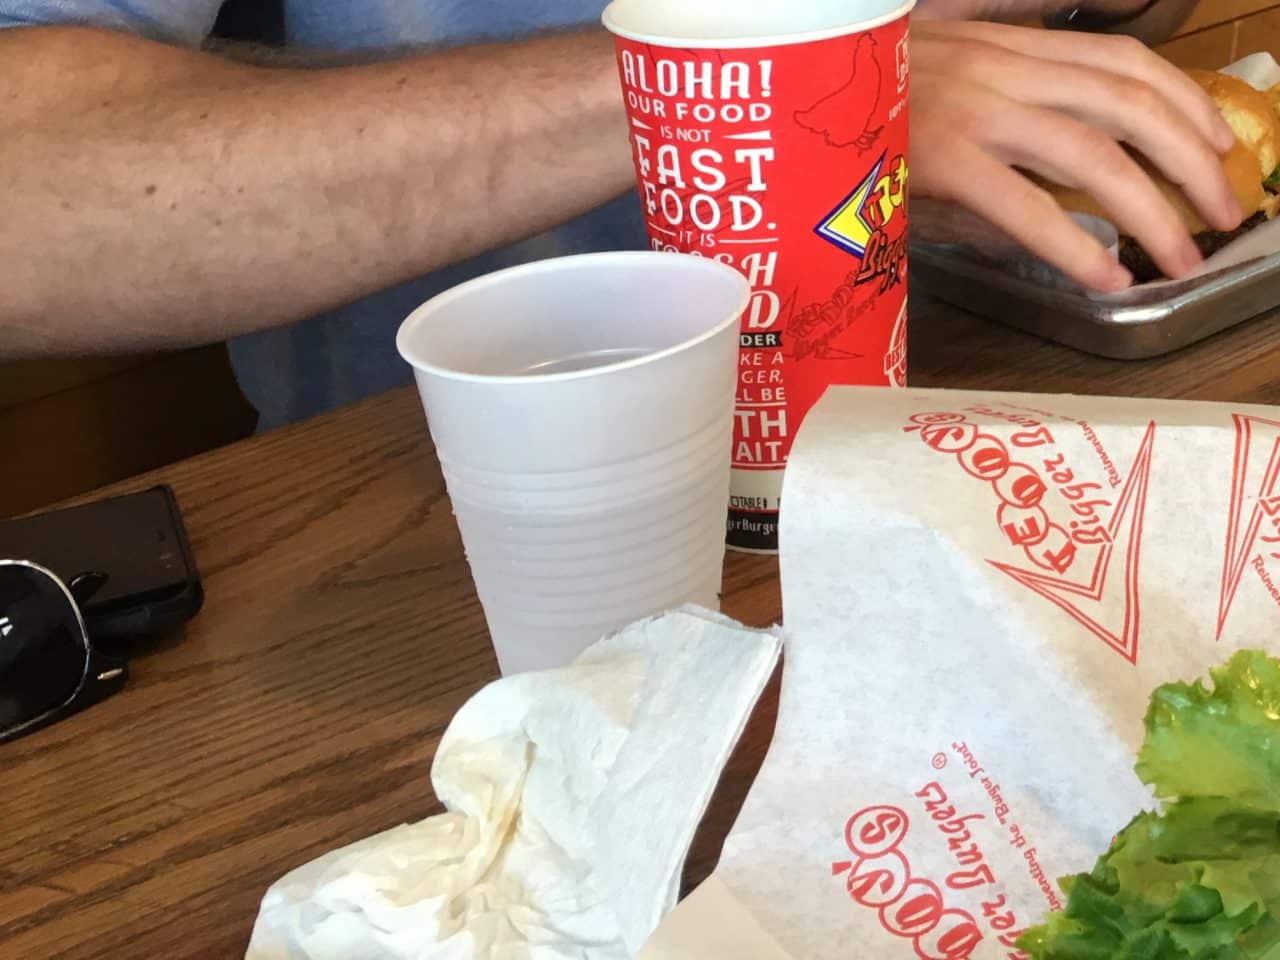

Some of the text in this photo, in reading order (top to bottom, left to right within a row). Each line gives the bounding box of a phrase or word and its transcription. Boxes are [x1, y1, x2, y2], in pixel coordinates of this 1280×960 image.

[621, 50, 773, 99] ALOHA!
[627, 91, 772, 122] OUR FOOD
[660, 126, 711, 142] IS NOT
[634, 134, 775, 192] FAST
[643, 180, 777, 231] FOOD.
[679, 230, 716, 247] IT IS
[740, 334, 777, 346] DER
[740, 351, 784, 365] KE A
[741, 369, 784, 384] GER,
[761, 387, 786, 401] BE
[734, 409, 787, 438] TH
[736, 441, 788, 461] AIT.
[1044, 453, 1113, 545] Bigger
[914, 781, 996, 890] Burgers
[1009, 823, 1026, 849] the
[832, 805, 984, 960] DDY'S
